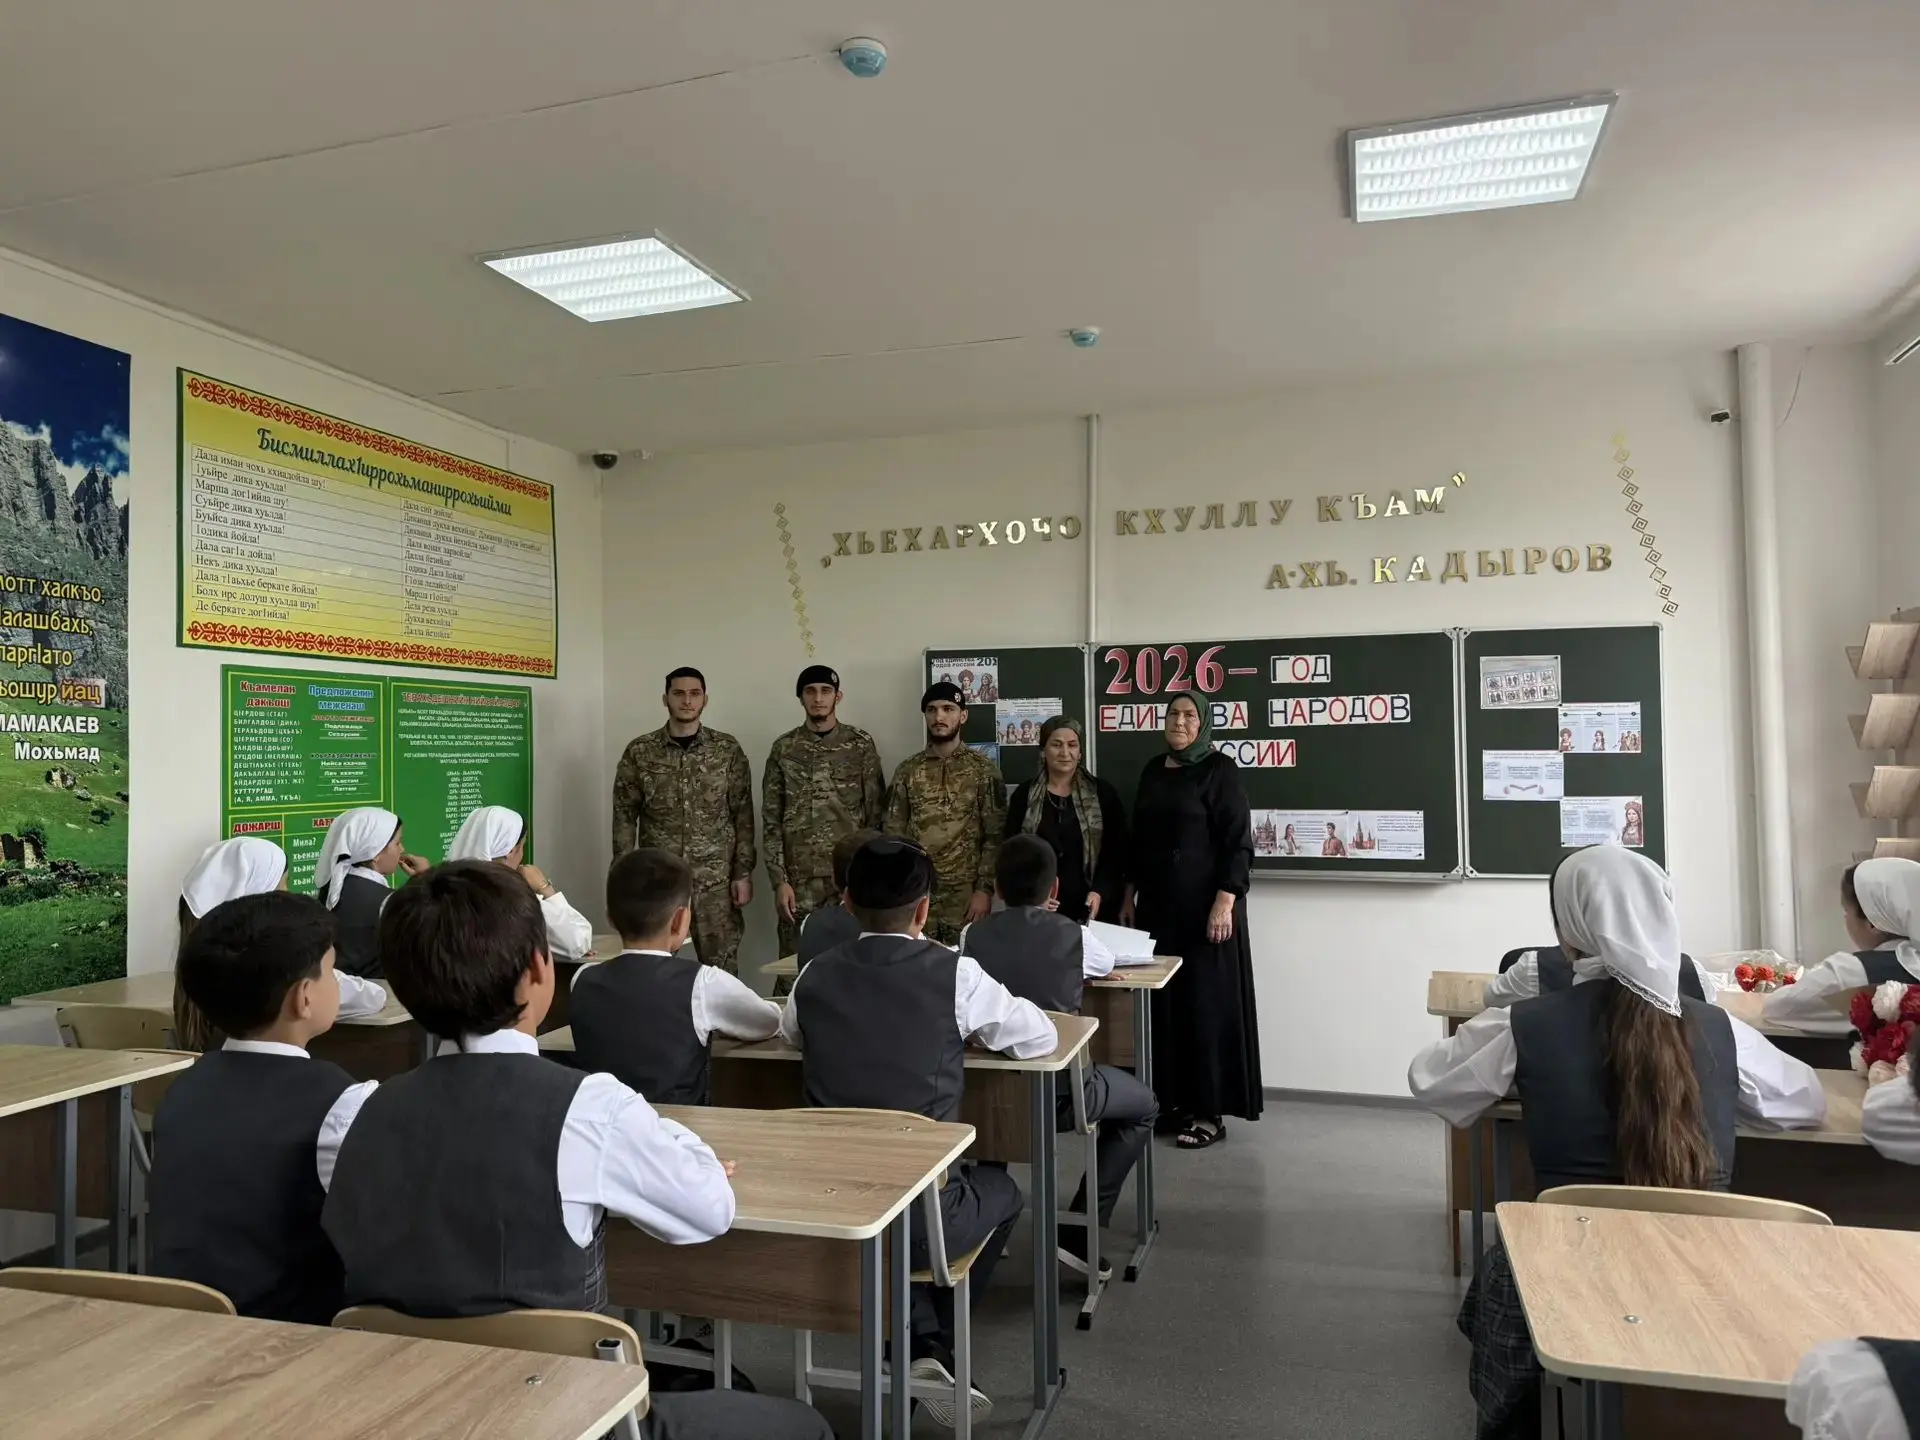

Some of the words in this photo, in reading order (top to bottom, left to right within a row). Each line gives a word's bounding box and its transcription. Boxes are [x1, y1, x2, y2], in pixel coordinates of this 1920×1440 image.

[195, 448, 218, 462] Дала
[220, 455, 244, 468] иман
[195, 478, 229, 495] Марша
[232, 473, 253, 485] дика
[195, 494, 229, 511] Суьйре
[232, 503, 252, 515] дика
[195, 509, 228, 524] Буьйса
[230, 517, 251, 528] дика
[1115, 499, 1293, 536] КХУЛЛУ
[195, 539, 219, 552] Дала
[230, 529, 260, 544] йойла!
[196, 555, 219, 567] Некъ
[222, 560, 243, 571] дика
[1373, 544, 1612, 584] КАДЫРОВ
[195, 569, 219, 582] Дала
[257, 578, 290, 592] беркате
[41, 579, 105, 604] халкъо,
[196, 585, 218, 597] Болх
[195, 600, 209, 611] Де
[210, 602, 246, 615] беркате
[1271, 655, 1330, 682] ГОД
[61, 680, 101, 704] йац
[240, 680, 296, 694] Къамелан
[246, 698, 291, 709] дакъош
[1269, 696, 1410, 725] НАРОДОВ
[14, 741, 100, 763] Мохьмад
[1210, 740, 1295, 767] ССИИ
[233, 821, 282, 834] ДОЖАРШ
[292, 837, 317, 848] Мила?
